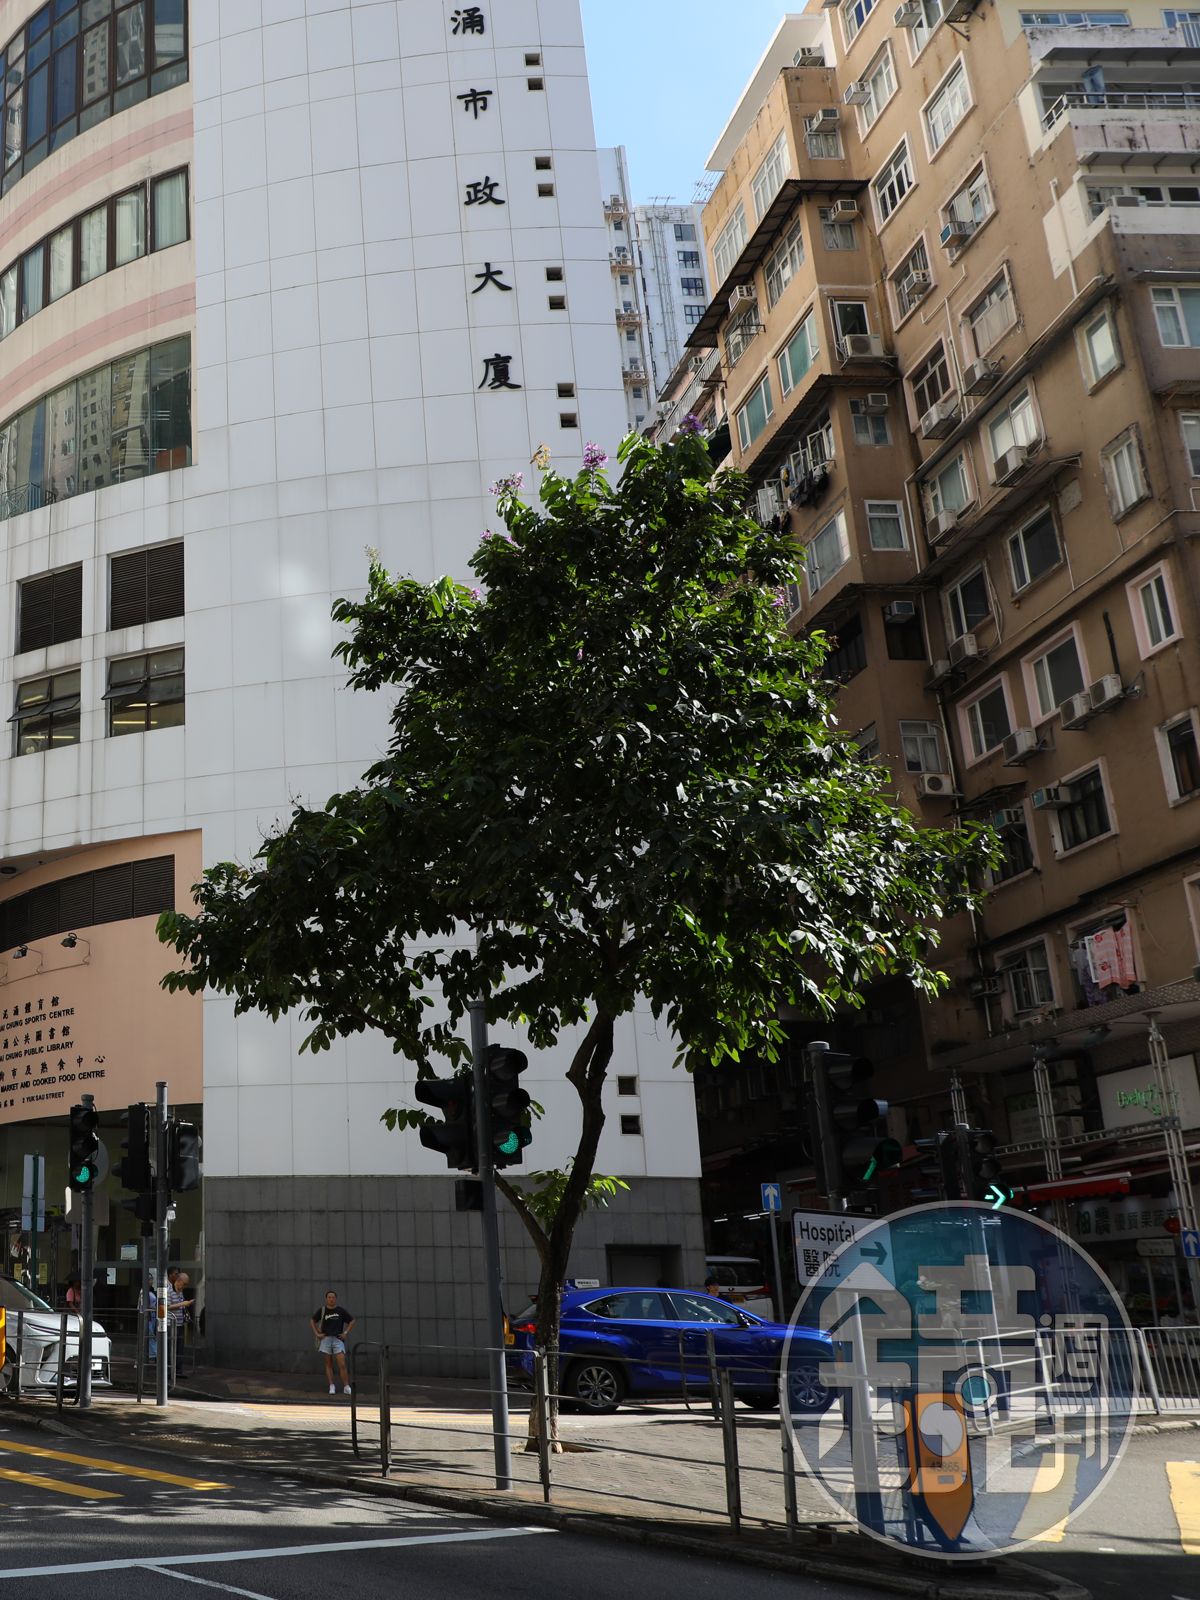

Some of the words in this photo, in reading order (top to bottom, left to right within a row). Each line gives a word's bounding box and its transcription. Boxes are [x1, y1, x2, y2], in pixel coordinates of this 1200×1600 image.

[450, 6, 522, 391] 涌市政大廈
[6, 1020, 23, 1030] CHUNG
[24, 1013, 47, 1025] SPORTS
[49, 1007, 75, 1019] CENTRE
[5, 1051, 23, 1061] CHUNG
[24, 1046, 45, 1056] PUBLIC
[46, 1041, 74, 1052] LIBRARY
[0, 1082, 19, 1093] MARKET
[20, 1079, 31, 1089] AND
[32, 1076, 57, 1086] COOKED
[58, 1073, 76, 1083] FOOD
[78, 1069, 106, 1080] CENTRE
[45, 1091, 65, 1100] STREET
[800, 1221, 856, 1245] Hospital
[803, 1249, 840, 1277] 醫院
